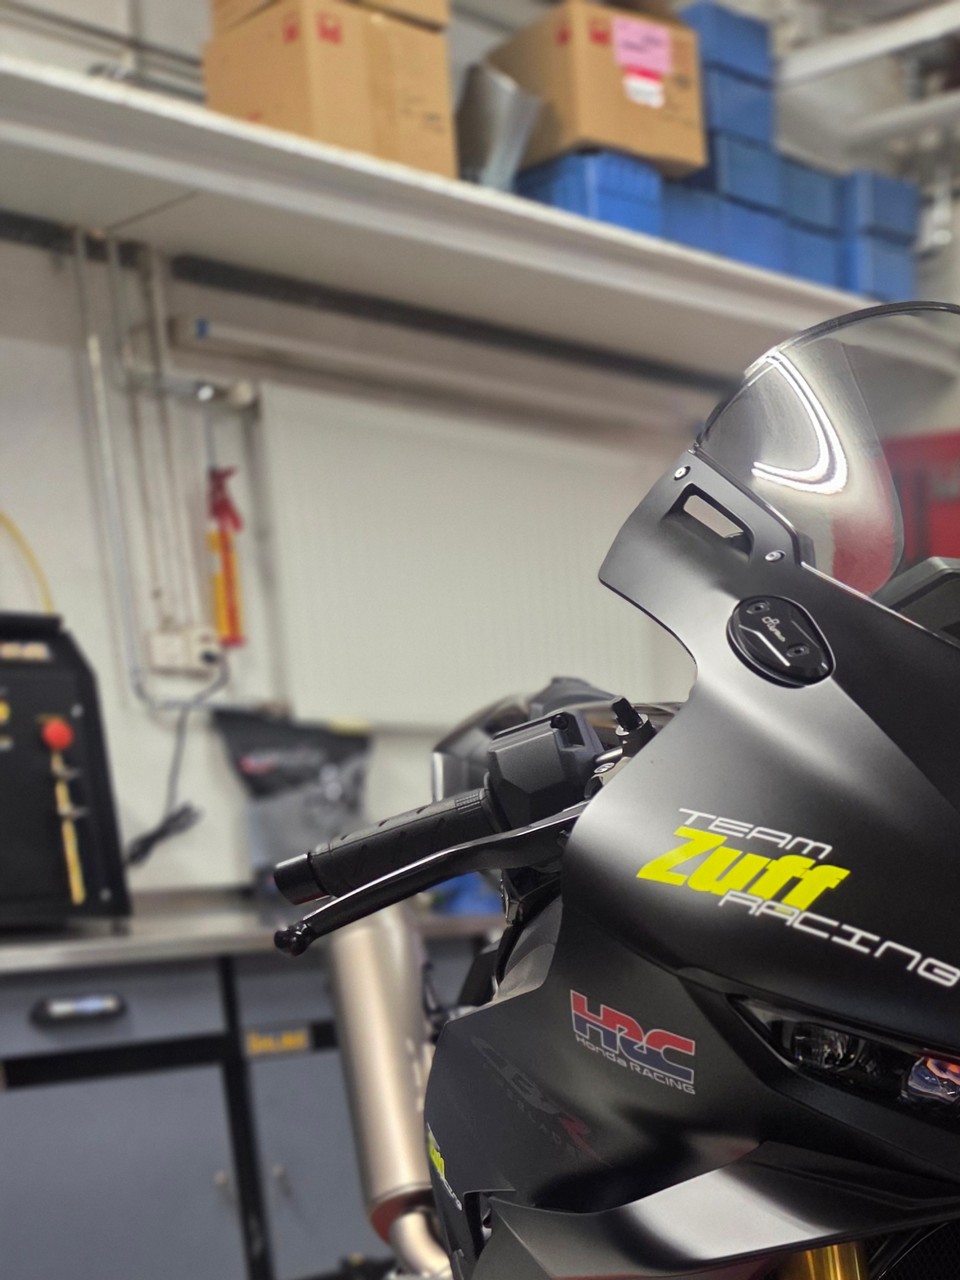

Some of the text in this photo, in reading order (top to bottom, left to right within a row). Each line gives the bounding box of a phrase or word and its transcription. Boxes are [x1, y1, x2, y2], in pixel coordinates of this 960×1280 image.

[635, 825, 852, 912] Zuff
[678, 807, 834, 860] TEAM
[570, 989, 696, 1085] HRC
[575, 1033, 696, 1096] Honda RACING
